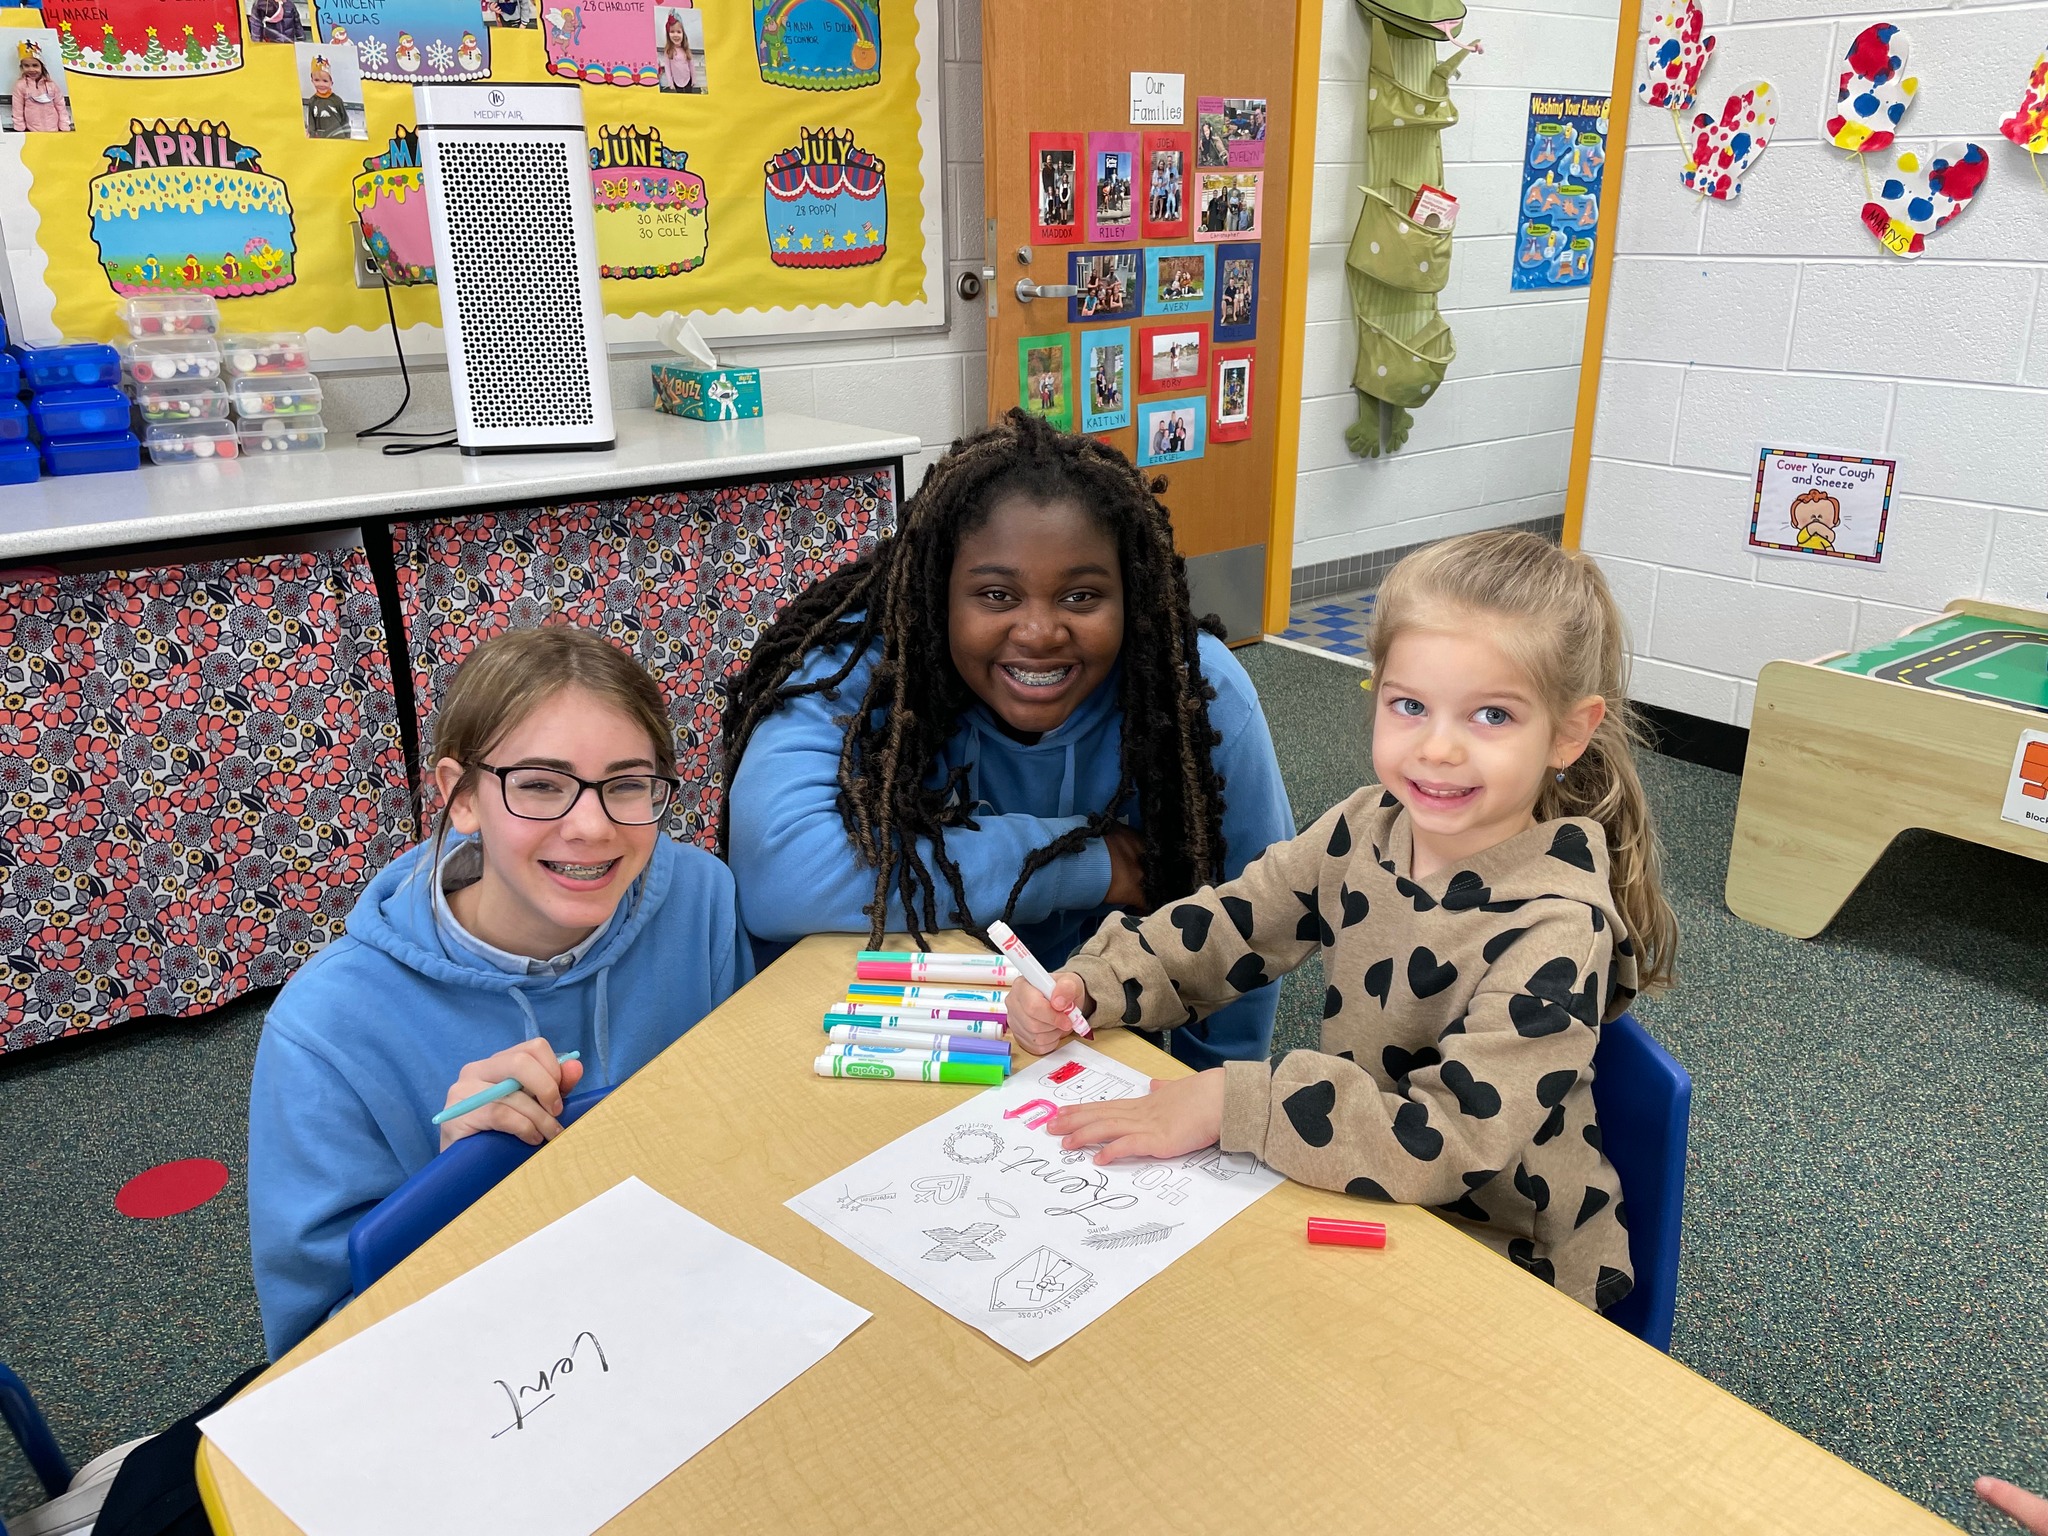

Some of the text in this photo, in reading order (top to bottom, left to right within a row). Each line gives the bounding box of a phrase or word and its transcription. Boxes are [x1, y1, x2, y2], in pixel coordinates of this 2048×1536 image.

[583, 0, 645, 12] 28 CHARLOTTE
[45, 7, 109, 22] 14 MAREN
[321, 12, 380, 25] 13 LUCAS
[1146, 76, 1165, 95] Our
[473, 110, 506, 119] MEDIFY
[1132, 99, 1182, 121] Families
[1531, 97, 1601, 120] Washing Your Hands
[1156, 138, 1175, 149] JOEY
[134, 134, 236, 169] APRIL
[600, 138, 662, 167] JUNE
[801, 139, 851, 166] JULY
[1229, 150, 1260, 162] EVELYN
[795, 202, 837, 217] 28 POPPY
[637, 212, 687, 226] 30 AVERY
[639, 227, 688, 239] 30 COLE
[1041, 227, 1073, 239] MADDOX
[1099, 227, 1126, 239] RILEY
[1162, 301, 1190, 313] AVERY
[675, 380, 701, 399] BUZZ
[1161, 379, 1183, 388] RORY
[1086, 414, 1126, 428] KAITLYN
[1149, 453, 1183, 464] EZEKIEL
[1776, 459, 1876, 482] Cover Your Cough
[1791, 475, 1855, 491] and Sneeze
[852, 1067, 891, 1077] Crayola
[998, 1146, 1139, 1226] Lent
[1132, 1165, 1193, 1206] 40
[860, 1193, 897, 1203] preparation
[1087, 1224, 1110, 1235] palms
[980, 1229, 1007, 1247] ashes
[1017, 1278, 1099, 1319] Stations of the Cross
[491, 1331, 609, 1439] Lent
